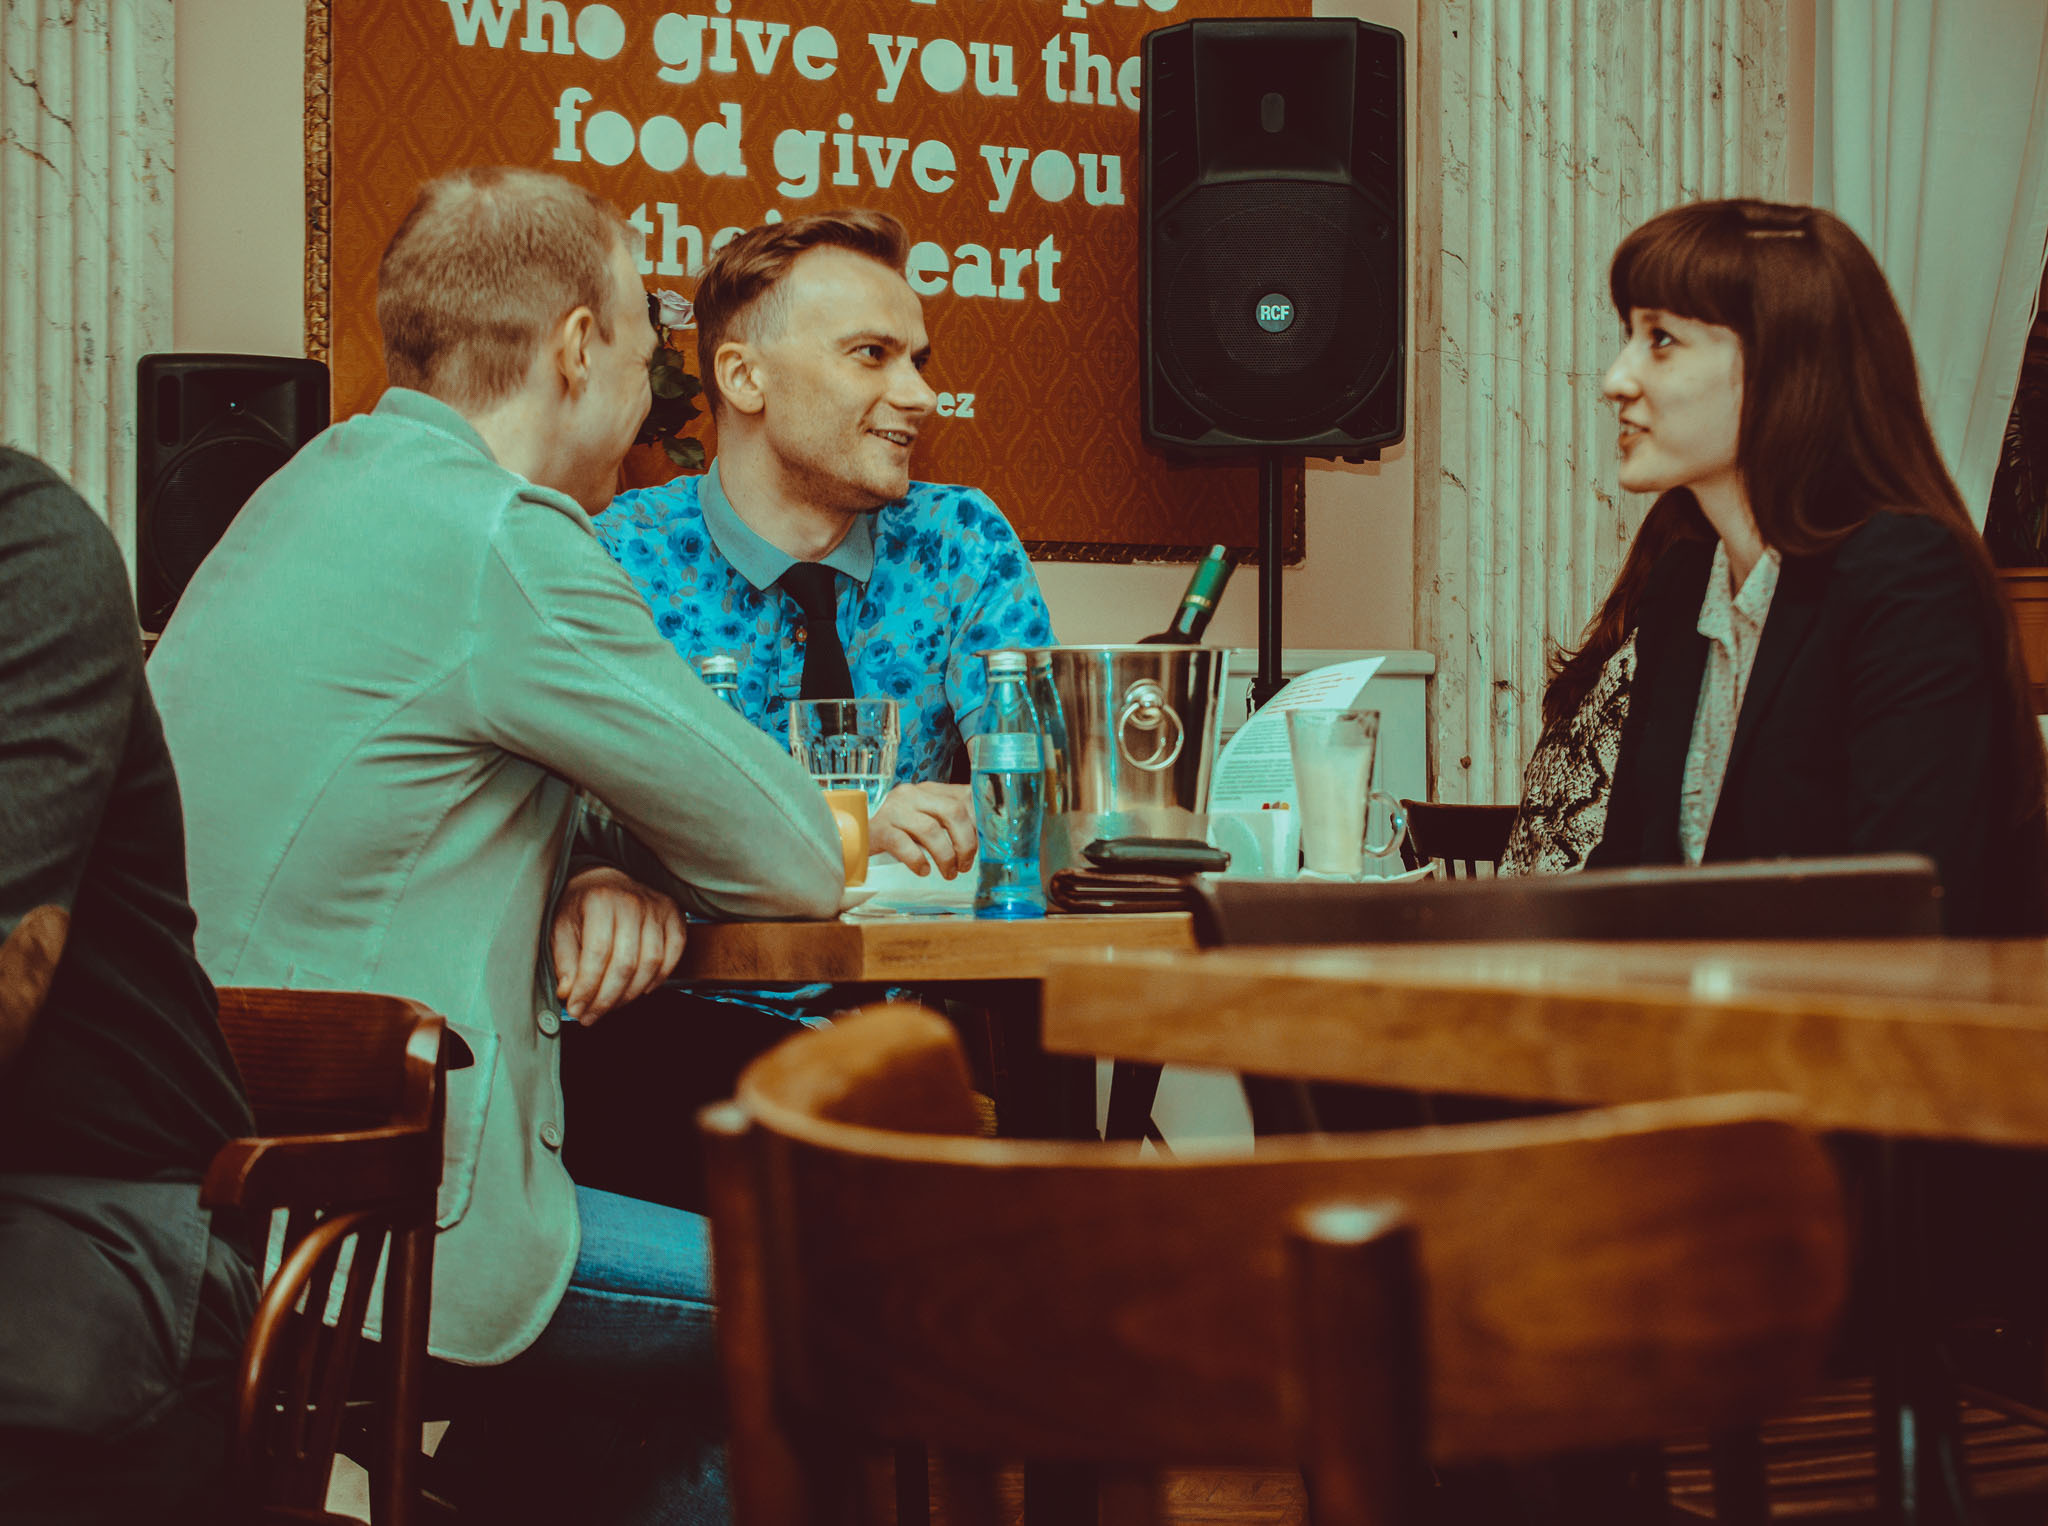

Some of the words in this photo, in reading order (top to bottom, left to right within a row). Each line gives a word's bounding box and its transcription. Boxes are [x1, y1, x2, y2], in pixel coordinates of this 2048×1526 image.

[441, 0, 626, 61] who
[652, 0, 839, 85] give
[868, 33, 1019, 103] you
[553, 87, 748, 178] food
[773, 113, 957, 199] give
[979, 144, 1125, 213] you
[905, 233, 1062, 303] eart
[1260, 304, 1290, 321] RCF
[935, 391, 976, 418] ez
